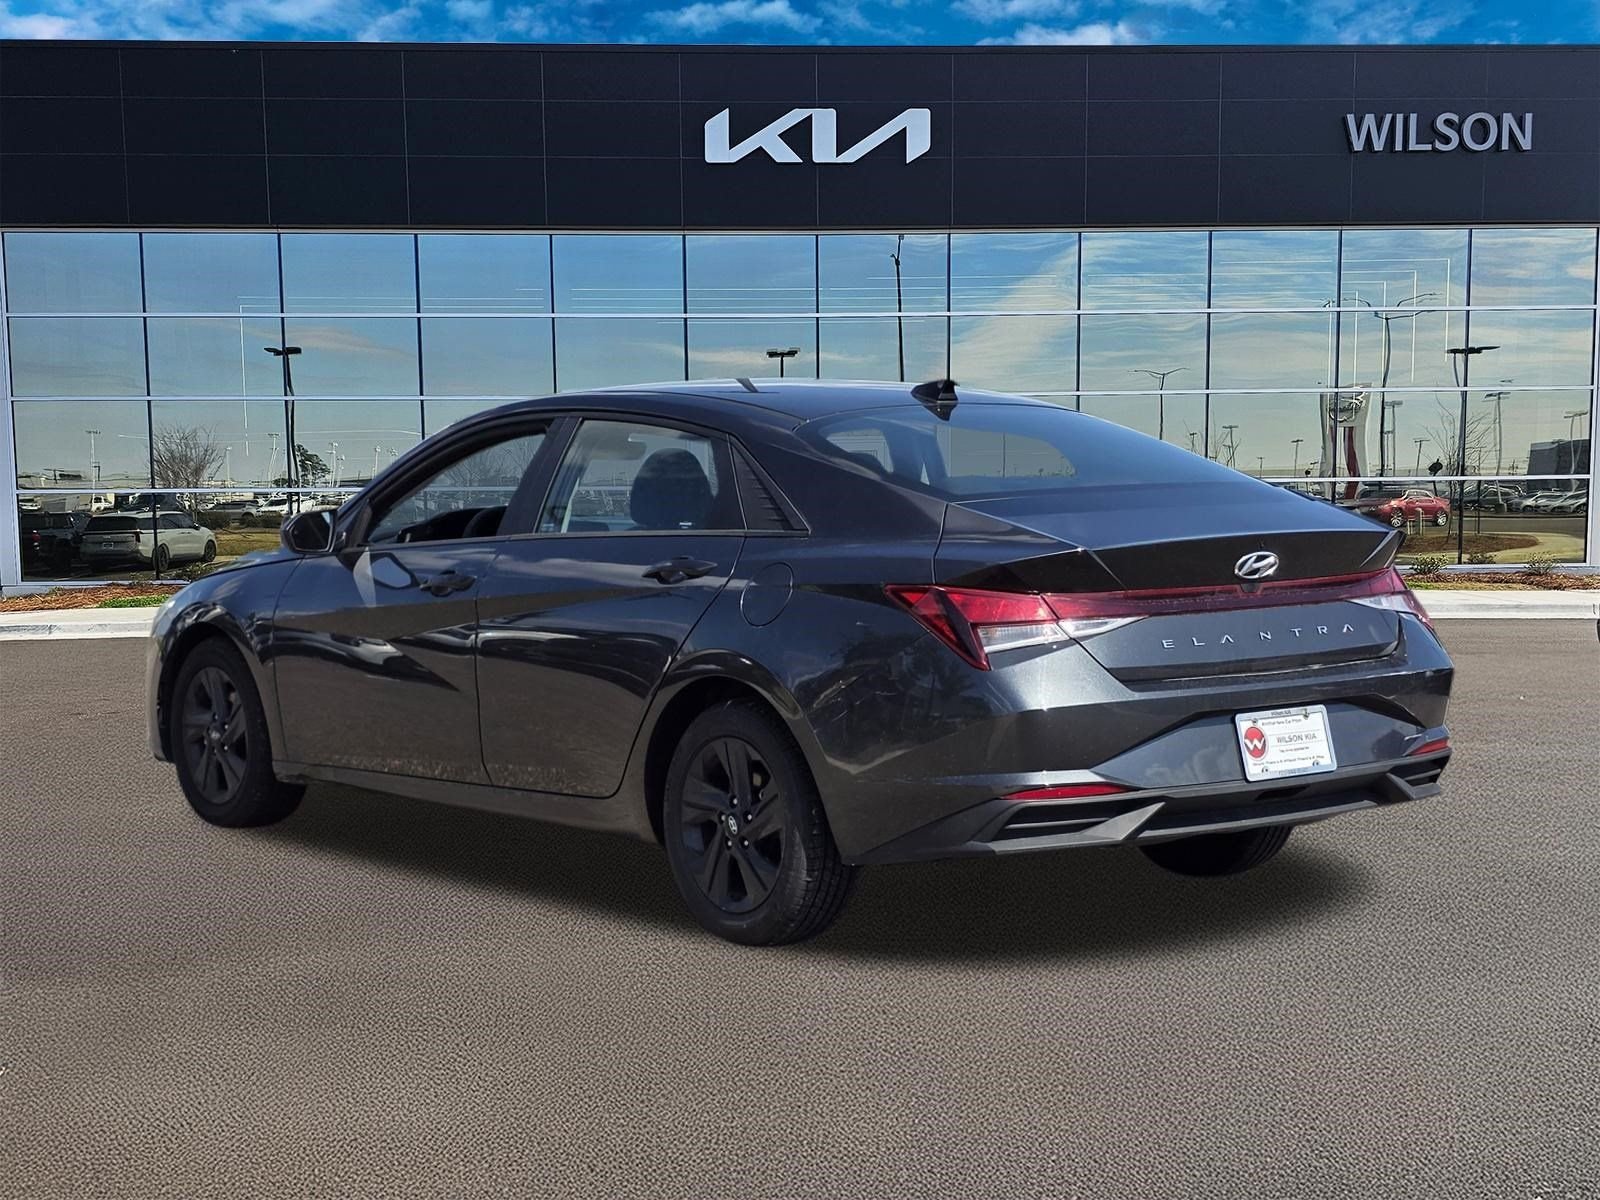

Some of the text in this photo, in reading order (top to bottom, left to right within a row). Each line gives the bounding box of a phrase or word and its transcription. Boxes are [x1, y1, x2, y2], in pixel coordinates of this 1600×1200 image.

[704, 108, 931, 164] KIA
[1345, 112, 1533, 151] WILSON
[1161, 623, 1355, 649] ELANTRA
[1276, 732, 1317, 744] WILSON KIA
